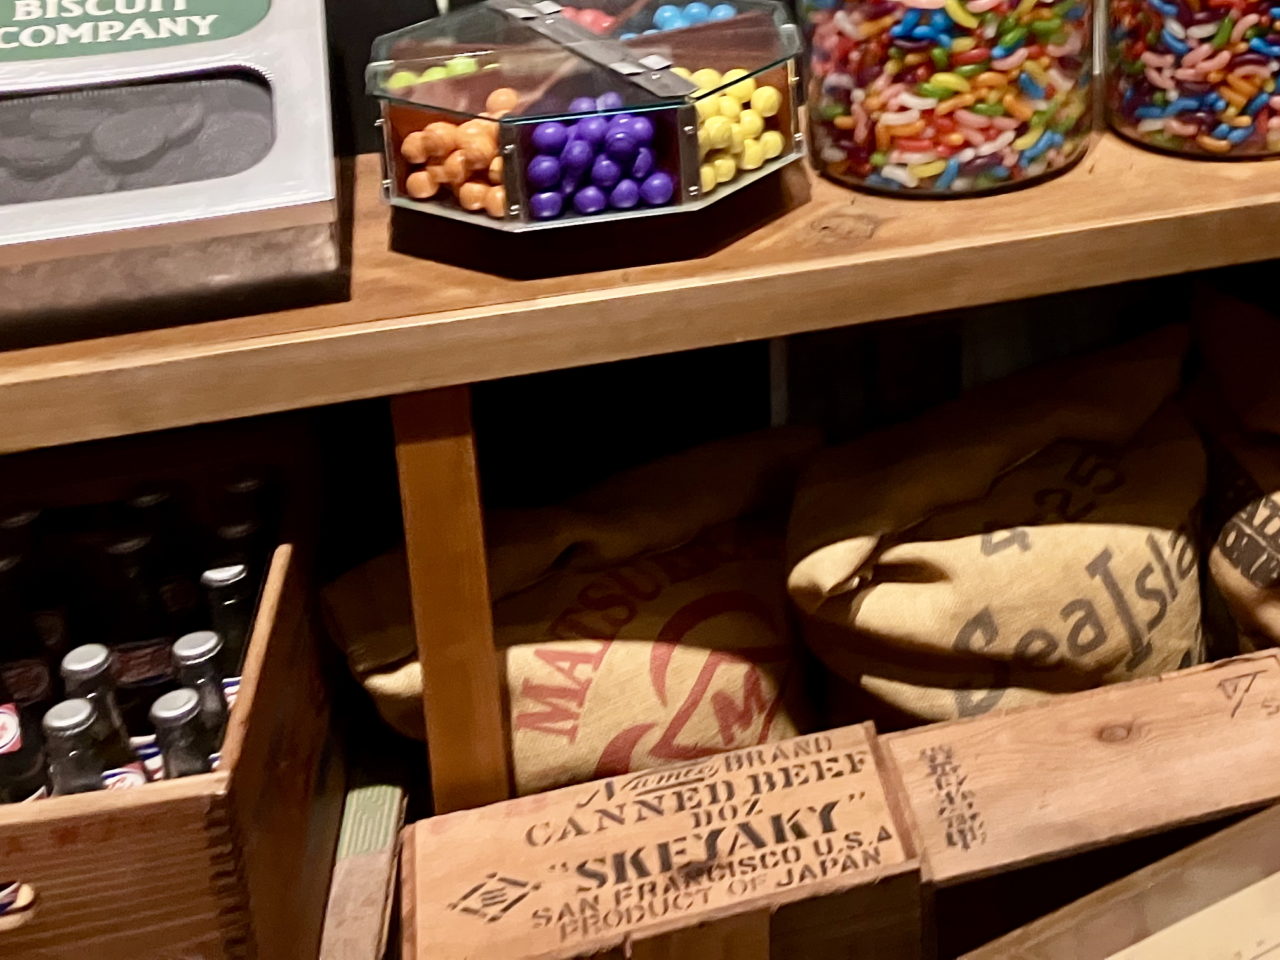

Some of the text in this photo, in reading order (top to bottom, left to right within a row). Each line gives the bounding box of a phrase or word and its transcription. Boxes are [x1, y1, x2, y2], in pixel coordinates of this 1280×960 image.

[0, 14, 219, 49] COMPANY
[524, 778, 736, 848] CANNED
[750, 749, 868, 796] BEEF
[724, 736, 832, 774] BRAND
[531, 894, 600, 929] SAN
[614, 842, 802, 908] FRANCISCO
[559, 886, 708, 943] PRODUCT
[727, 876, 767, 897] OF
[777, 845, 883, 888] JAPAN
